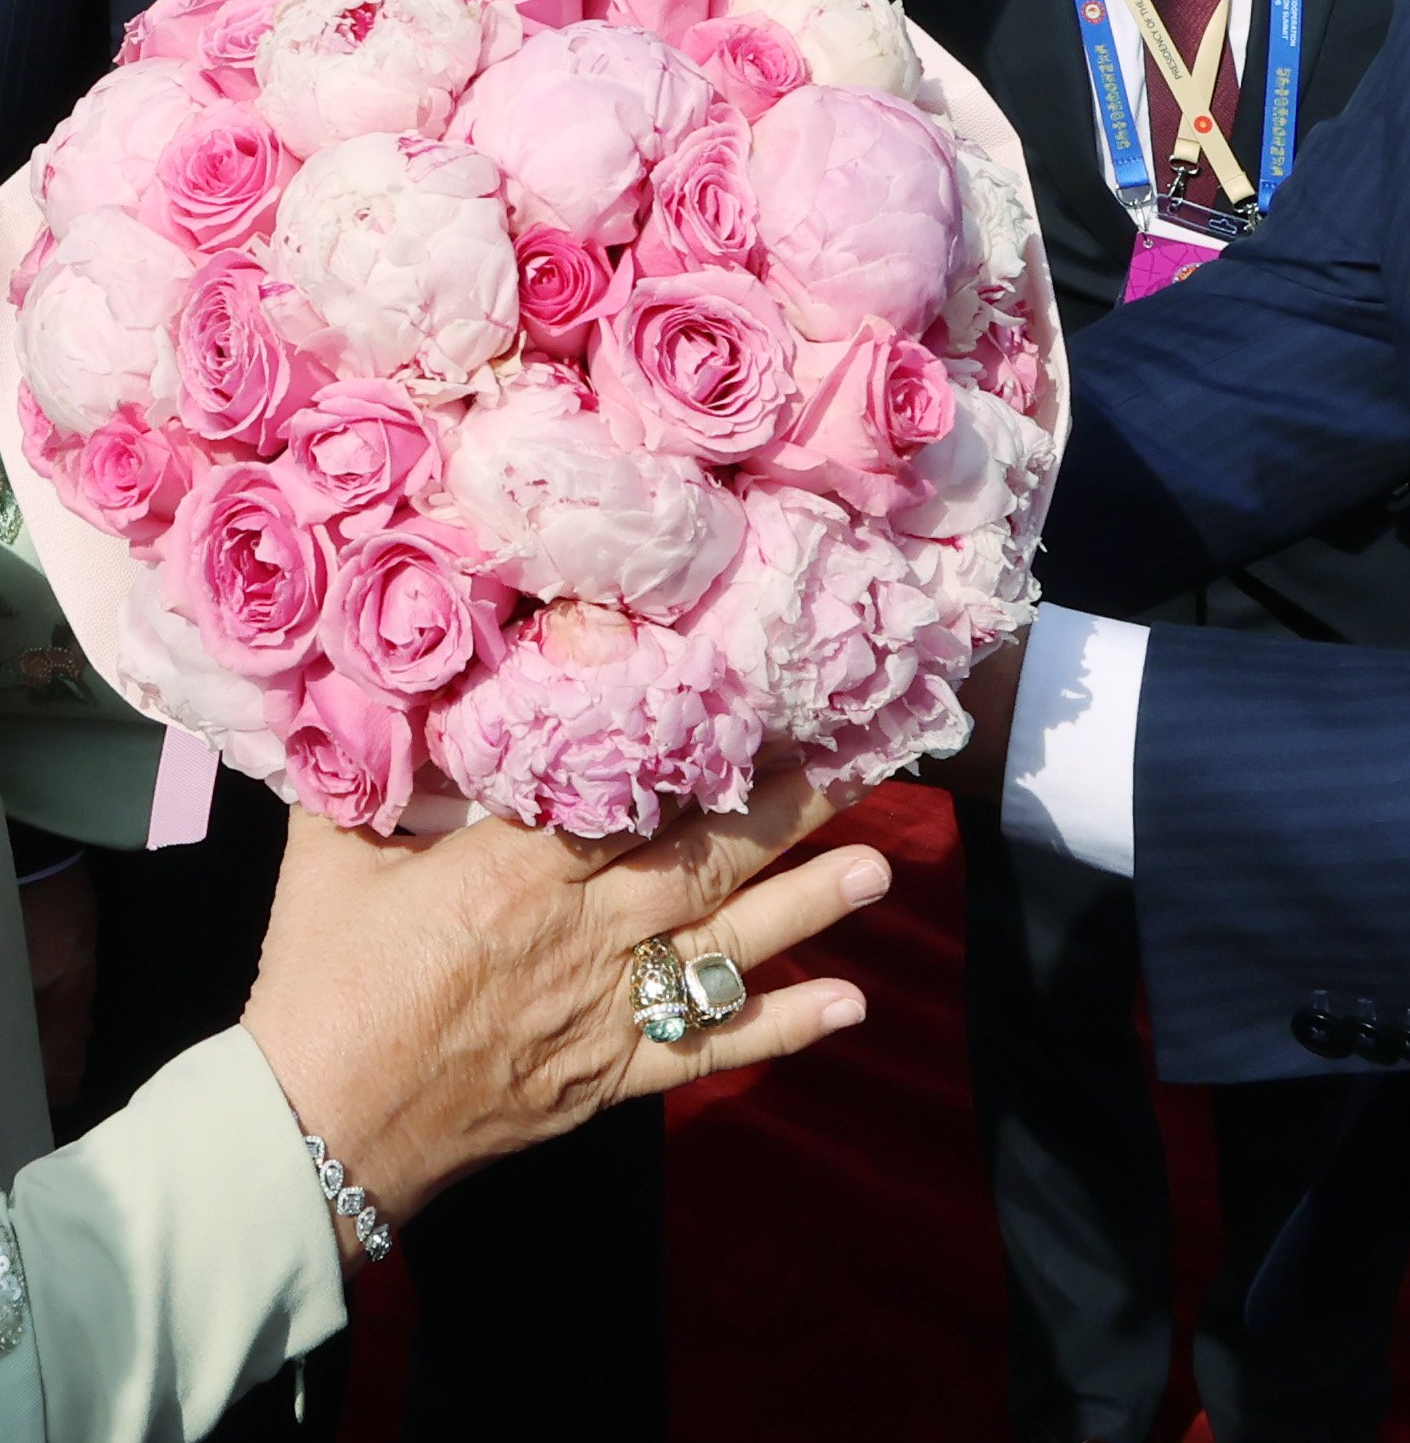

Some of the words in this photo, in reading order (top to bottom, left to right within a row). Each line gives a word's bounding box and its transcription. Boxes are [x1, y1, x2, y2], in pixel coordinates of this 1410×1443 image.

[1136, 0, 1148, 16] THE
[1145, 18, 1155, 29] OF
[1151, 30, 1182, 80] PRESIDENCY
